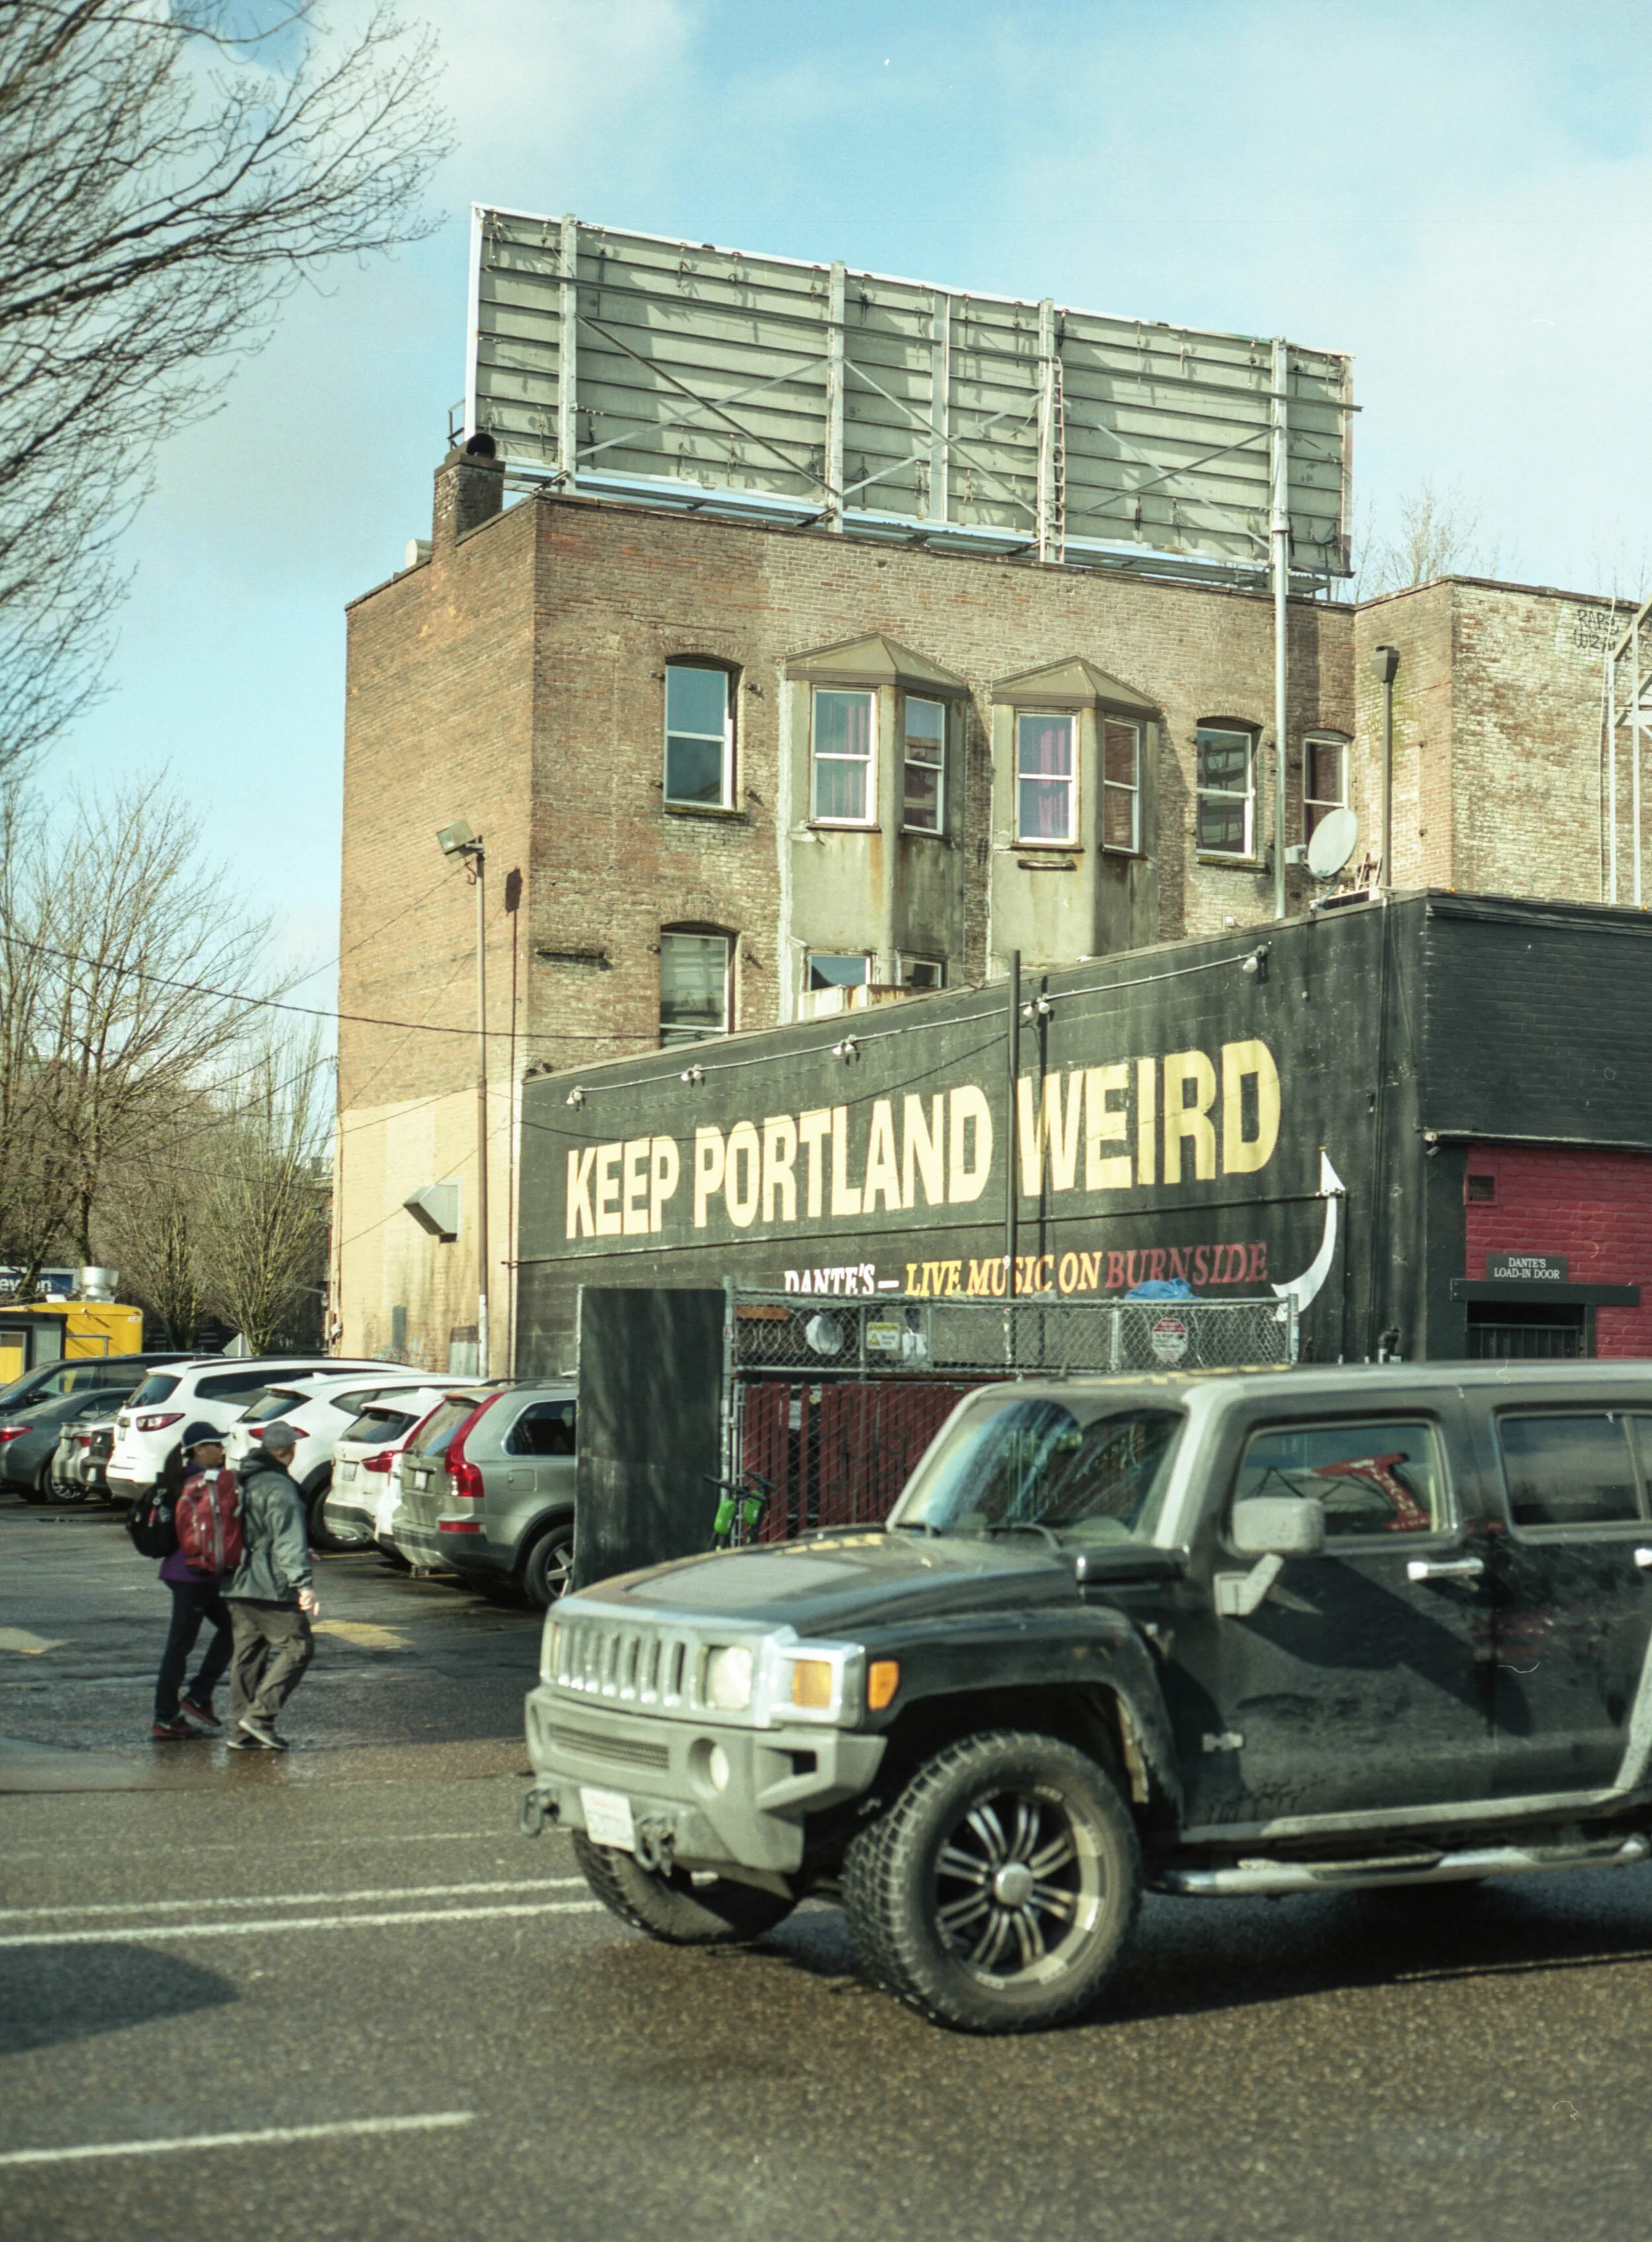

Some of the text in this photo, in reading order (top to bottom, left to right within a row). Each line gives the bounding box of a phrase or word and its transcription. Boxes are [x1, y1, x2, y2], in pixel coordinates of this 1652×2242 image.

[566, 1039, 1281, 1239] KEEP PORTLAND WEIRD
[784, 1263, 875, 1295] DANTE'S
[904, 1259, 962, 1296] LIVE
[966, 1255, 1054, 1296] MUSIC
[1059, 1252, 1102, 1293] ON
[1106, 1242, 1267, 1289] BURNSIDE
[1494, 1267, 1560, 1279] LOAD-IN DOOR
[1509, 1257, 1546, 1268] DANTE'S
